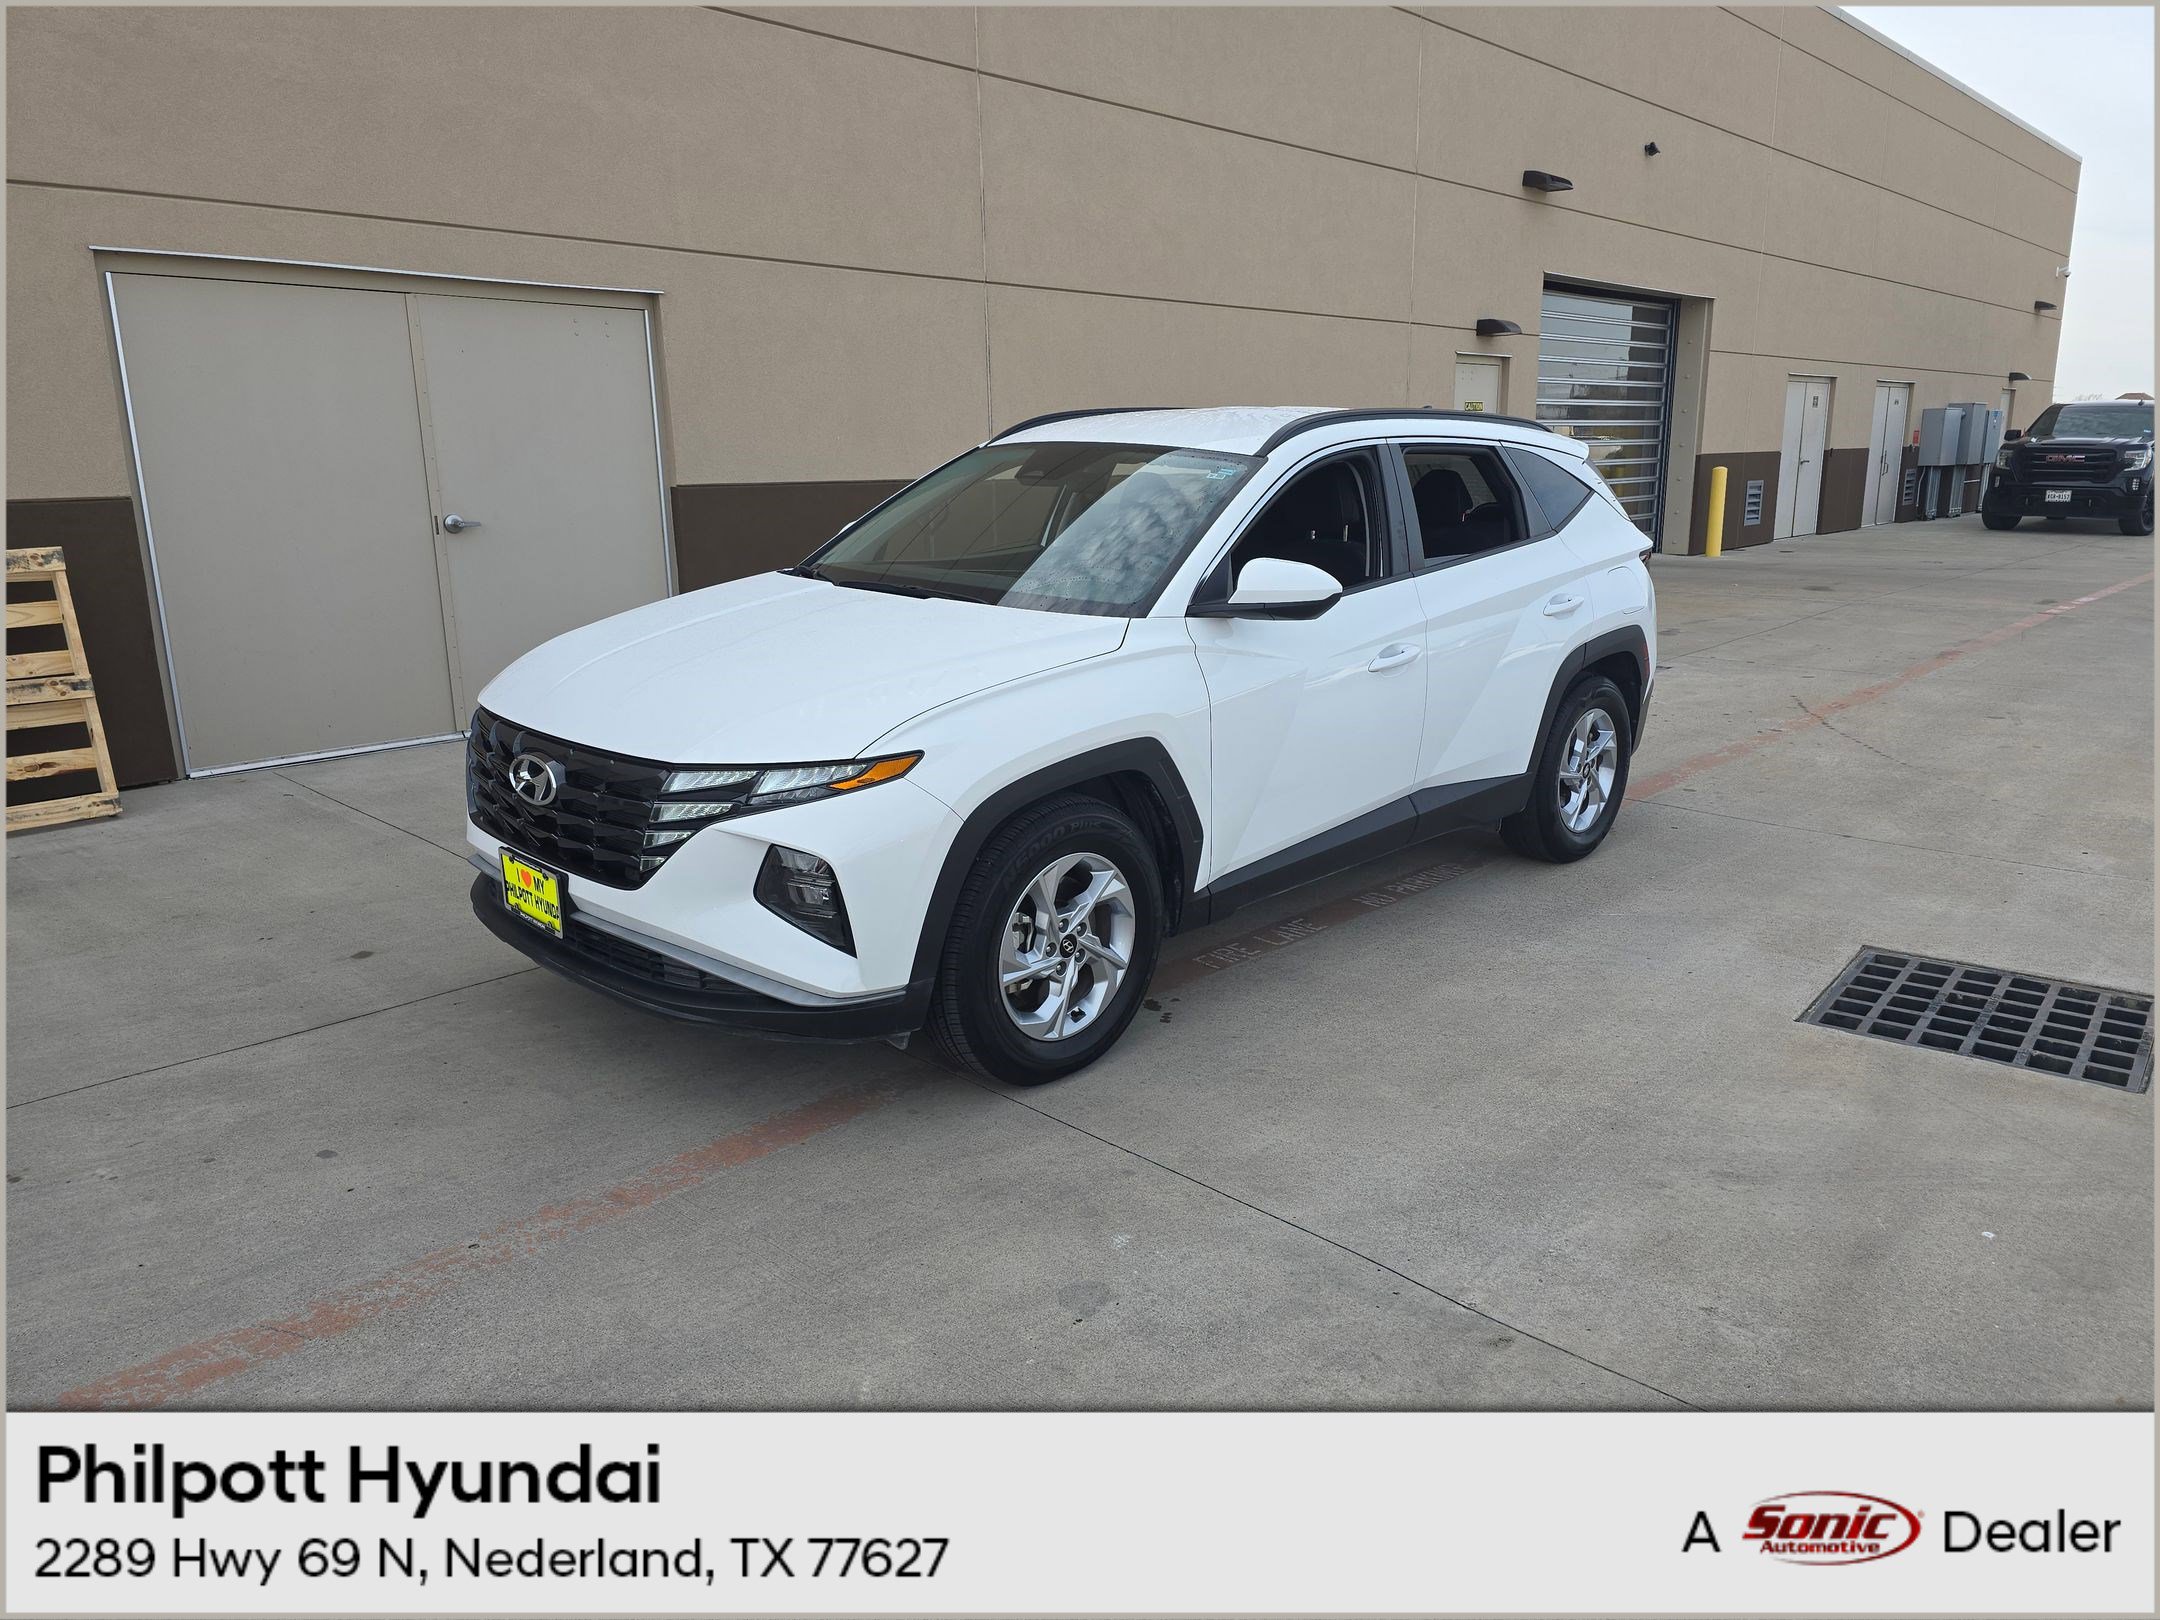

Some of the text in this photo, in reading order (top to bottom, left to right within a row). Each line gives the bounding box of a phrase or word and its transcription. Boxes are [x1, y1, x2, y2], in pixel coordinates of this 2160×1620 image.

[2046, 455, 2085, 463] GMC
[516, 868, 544, 894] I MY
[505, 880, 560, 920] PHILPOTT HYUNDA
[1351, 892, 1397, 908] NO
[1193, 918, 1328, 969] FIRE LANE
